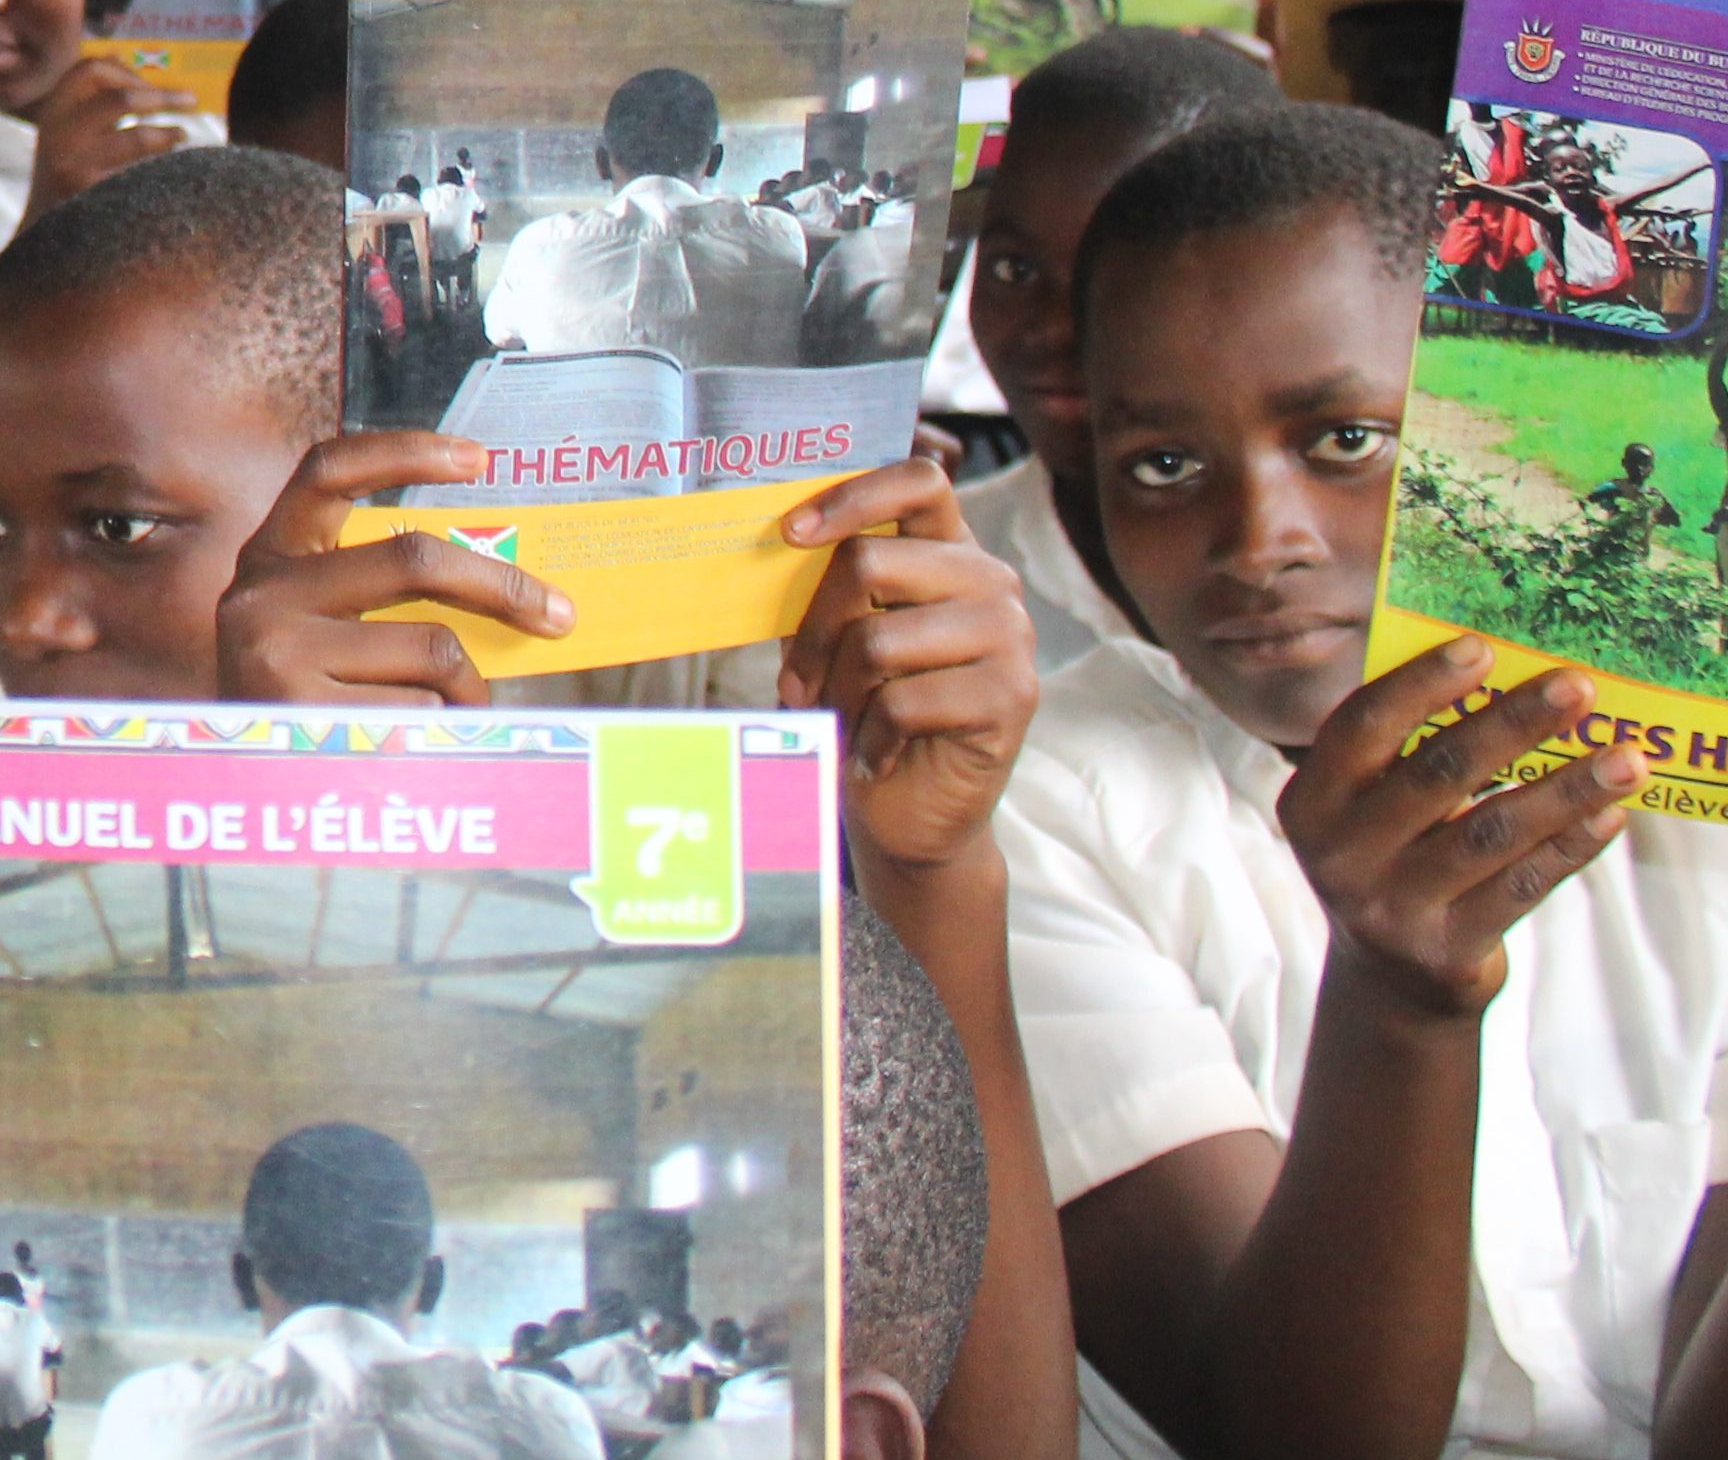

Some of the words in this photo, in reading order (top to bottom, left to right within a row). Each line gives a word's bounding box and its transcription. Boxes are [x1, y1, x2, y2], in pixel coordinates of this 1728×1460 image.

[1580, 27, 1680, 58] RÉPUBLIQUE
[1681, 49, 1706, 64] DU
[462, 423, 852, 486] THÉMATIQUES
[166, 802, 248, 854] DE
[261, 792, 497, 856] L'ÉLÈVE
[612, 892, 722, 925] ANNÉE
